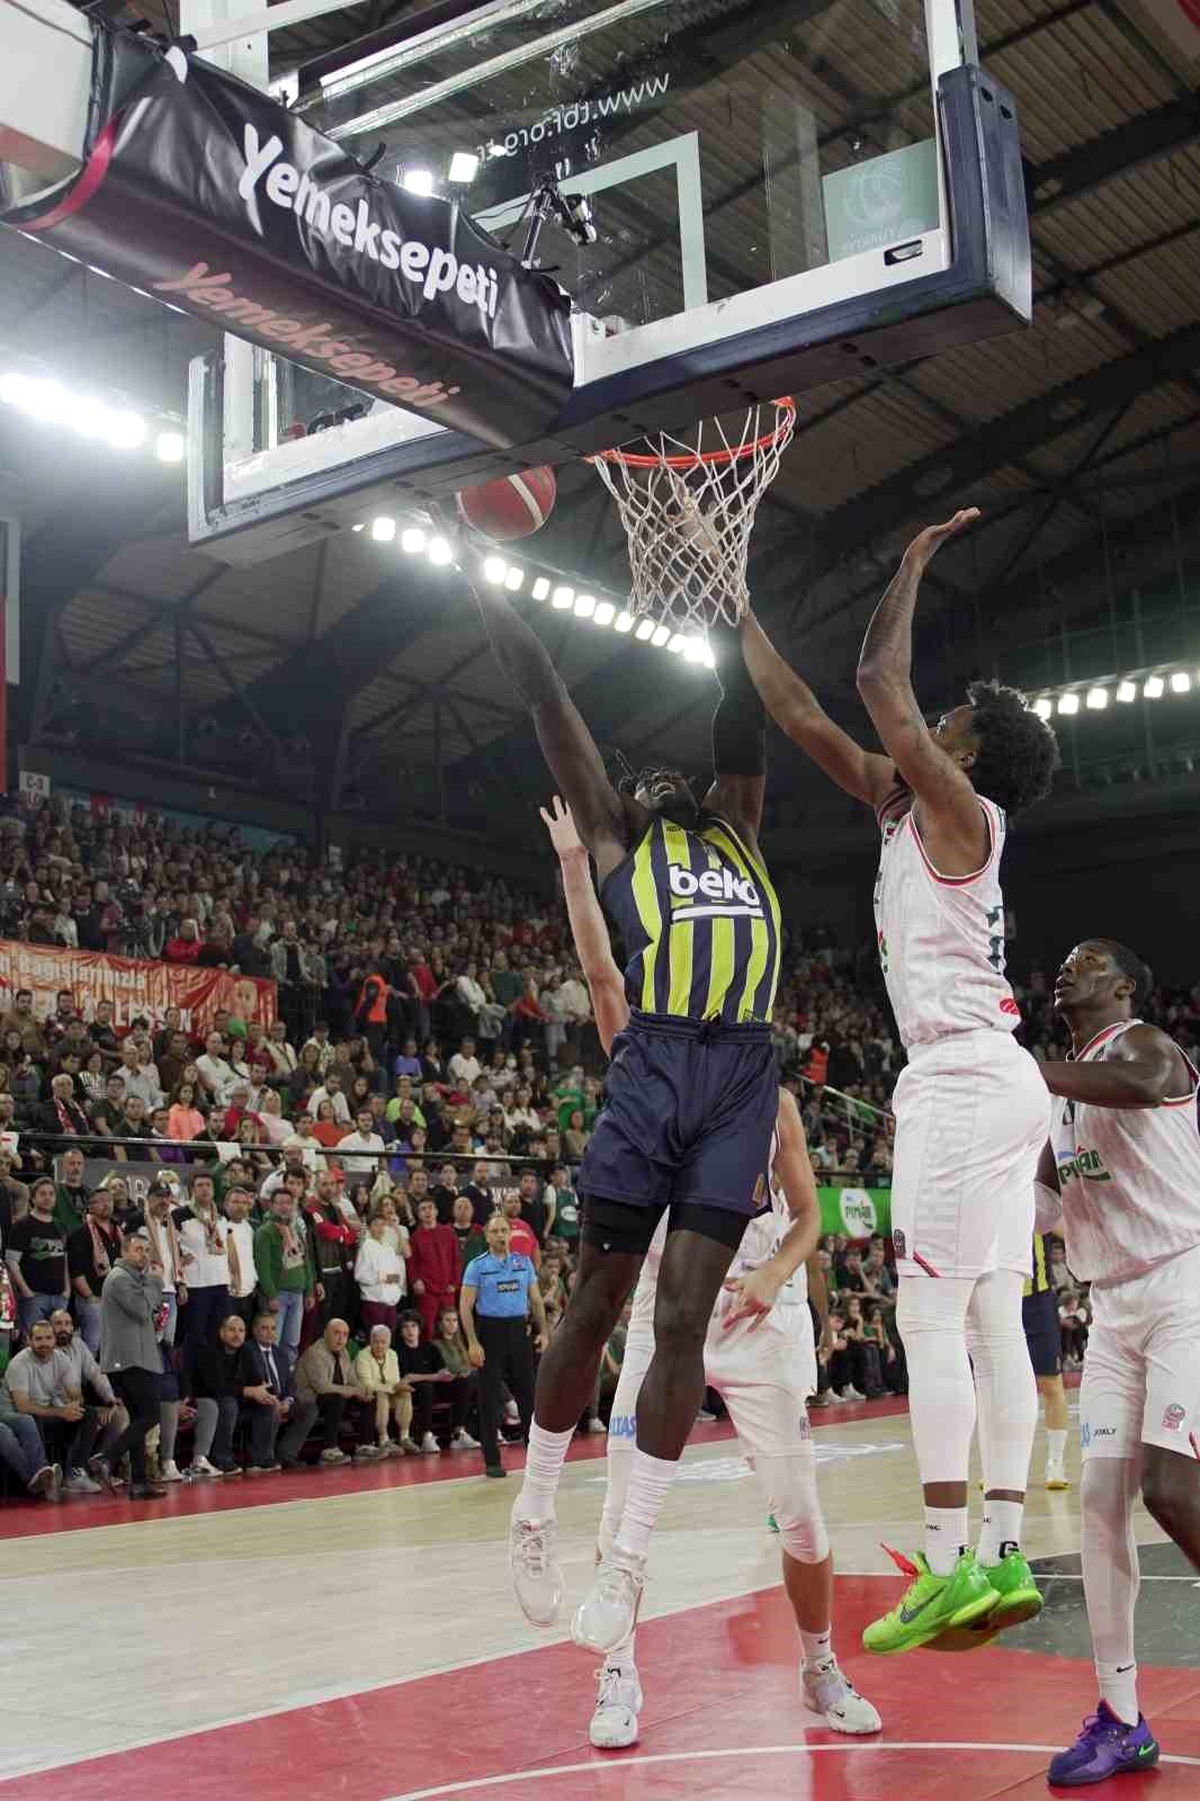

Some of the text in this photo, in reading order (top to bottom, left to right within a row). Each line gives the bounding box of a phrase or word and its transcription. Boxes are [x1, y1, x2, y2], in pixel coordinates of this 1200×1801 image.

[238, 123, 499, 319] Yemeksepeti
[153, 261, 461, 407] Yemeksepeti
[668, 864, 761, 907] beko
